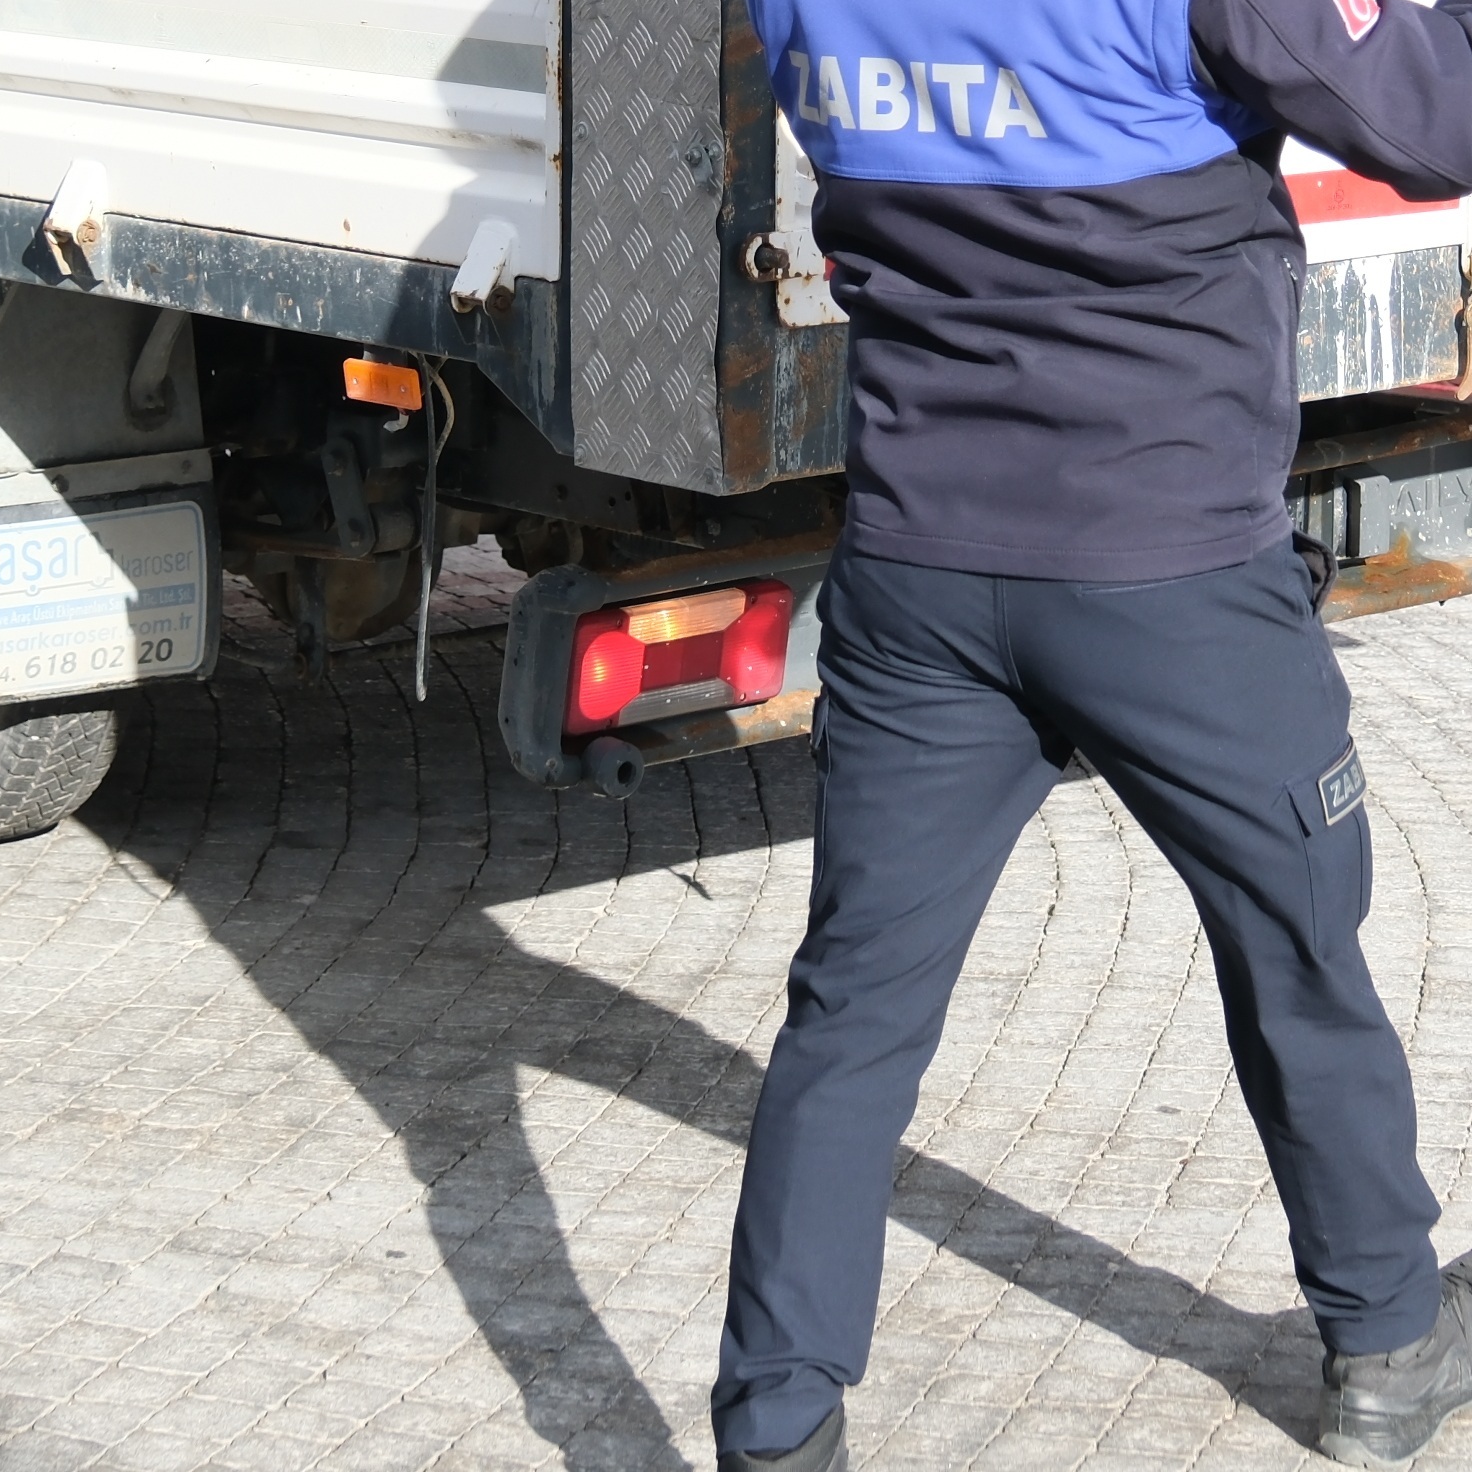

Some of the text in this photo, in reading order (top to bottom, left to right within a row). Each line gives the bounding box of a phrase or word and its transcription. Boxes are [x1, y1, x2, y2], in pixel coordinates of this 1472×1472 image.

[788, 49, 1049, 138] ZABITA
[11, 610, 32, 626] Araç
[33, 605, 55, 621] Üstü
[25, 651, 77, 679] 618
[91, 644, 126, 671] 02
[137, 638, 174, 665] 20
